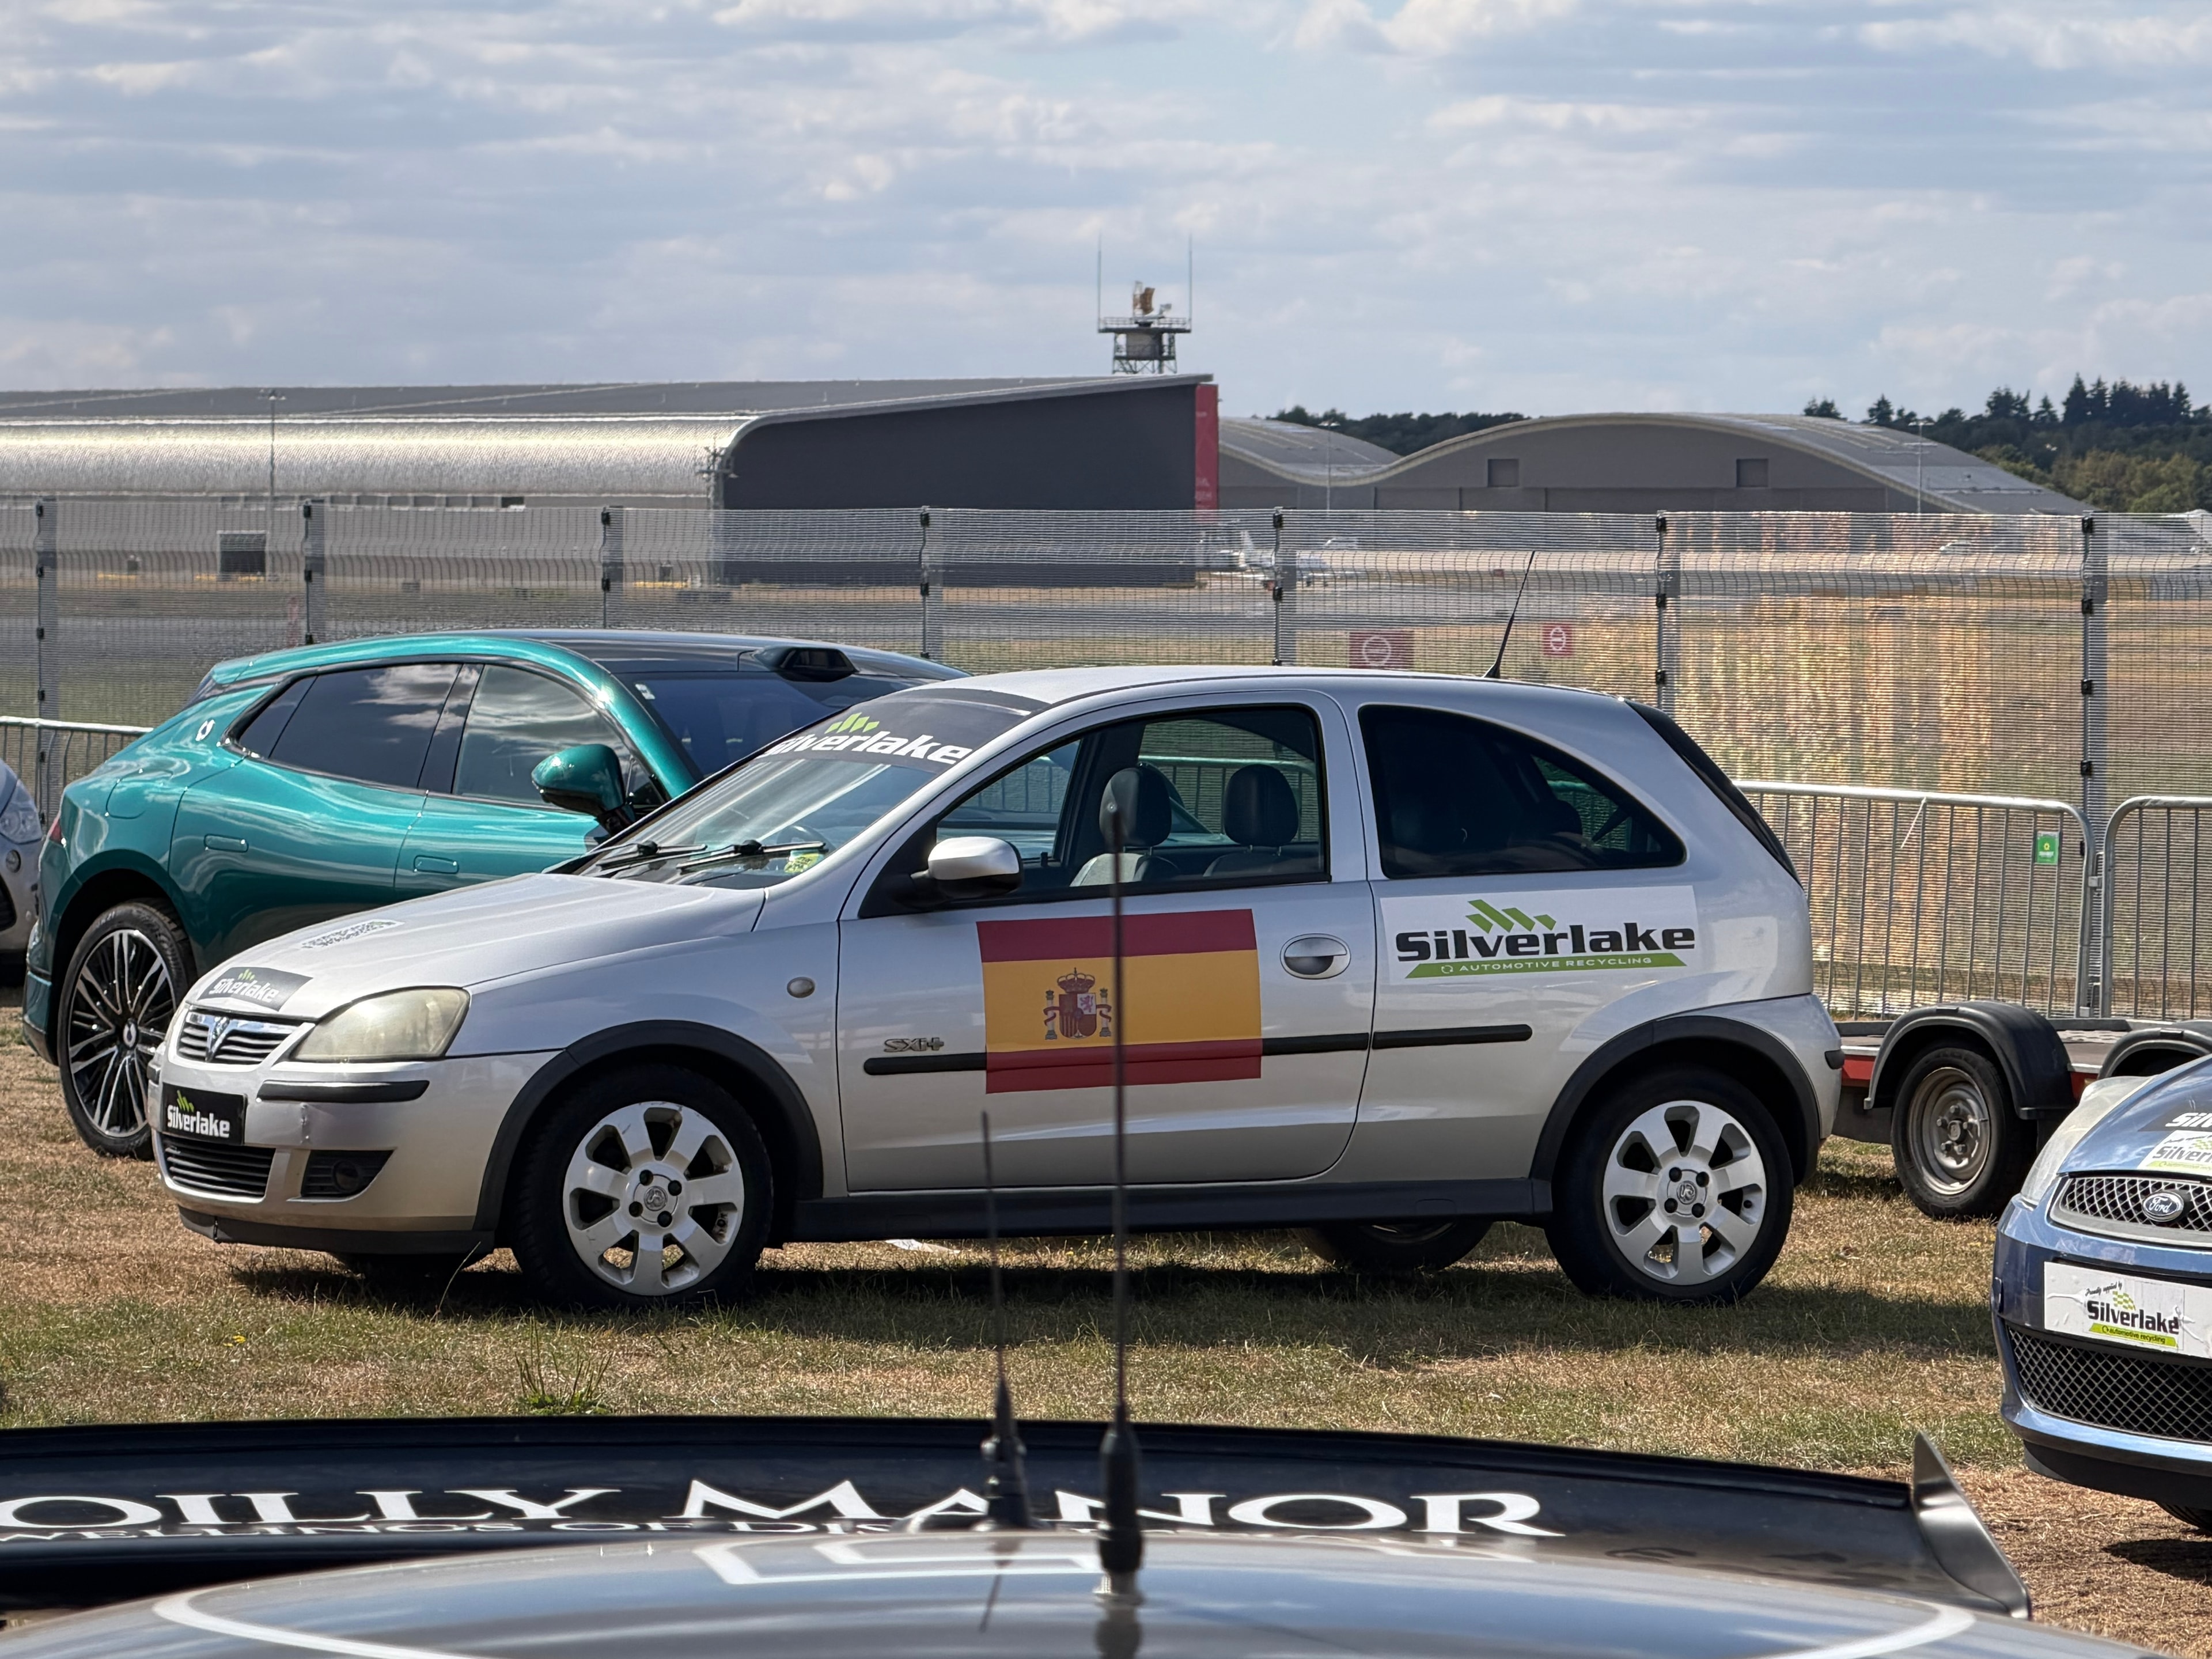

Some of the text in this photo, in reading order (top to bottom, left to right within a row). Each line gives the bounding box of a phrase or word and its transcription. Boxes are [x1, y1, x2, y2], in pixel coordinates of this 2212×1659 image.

[754, 730, 974, 765] Silverlake
[1395, 922, 1695, 962] Silverlake
[1459, 957, 1652, 972] AUTOMOTIVE RECYCLING
[209, 978, 280, 1003] Silverlake
[167, 1104, 230, 1138] Silverlake
[2148, 1196, 2173, 1214] Ford
[2086, 1300, 2180, 1335] Silverlake
[2140, 1334, 2166, 1344] recycling
[662, 1479, 1566, 1536] MANOR
